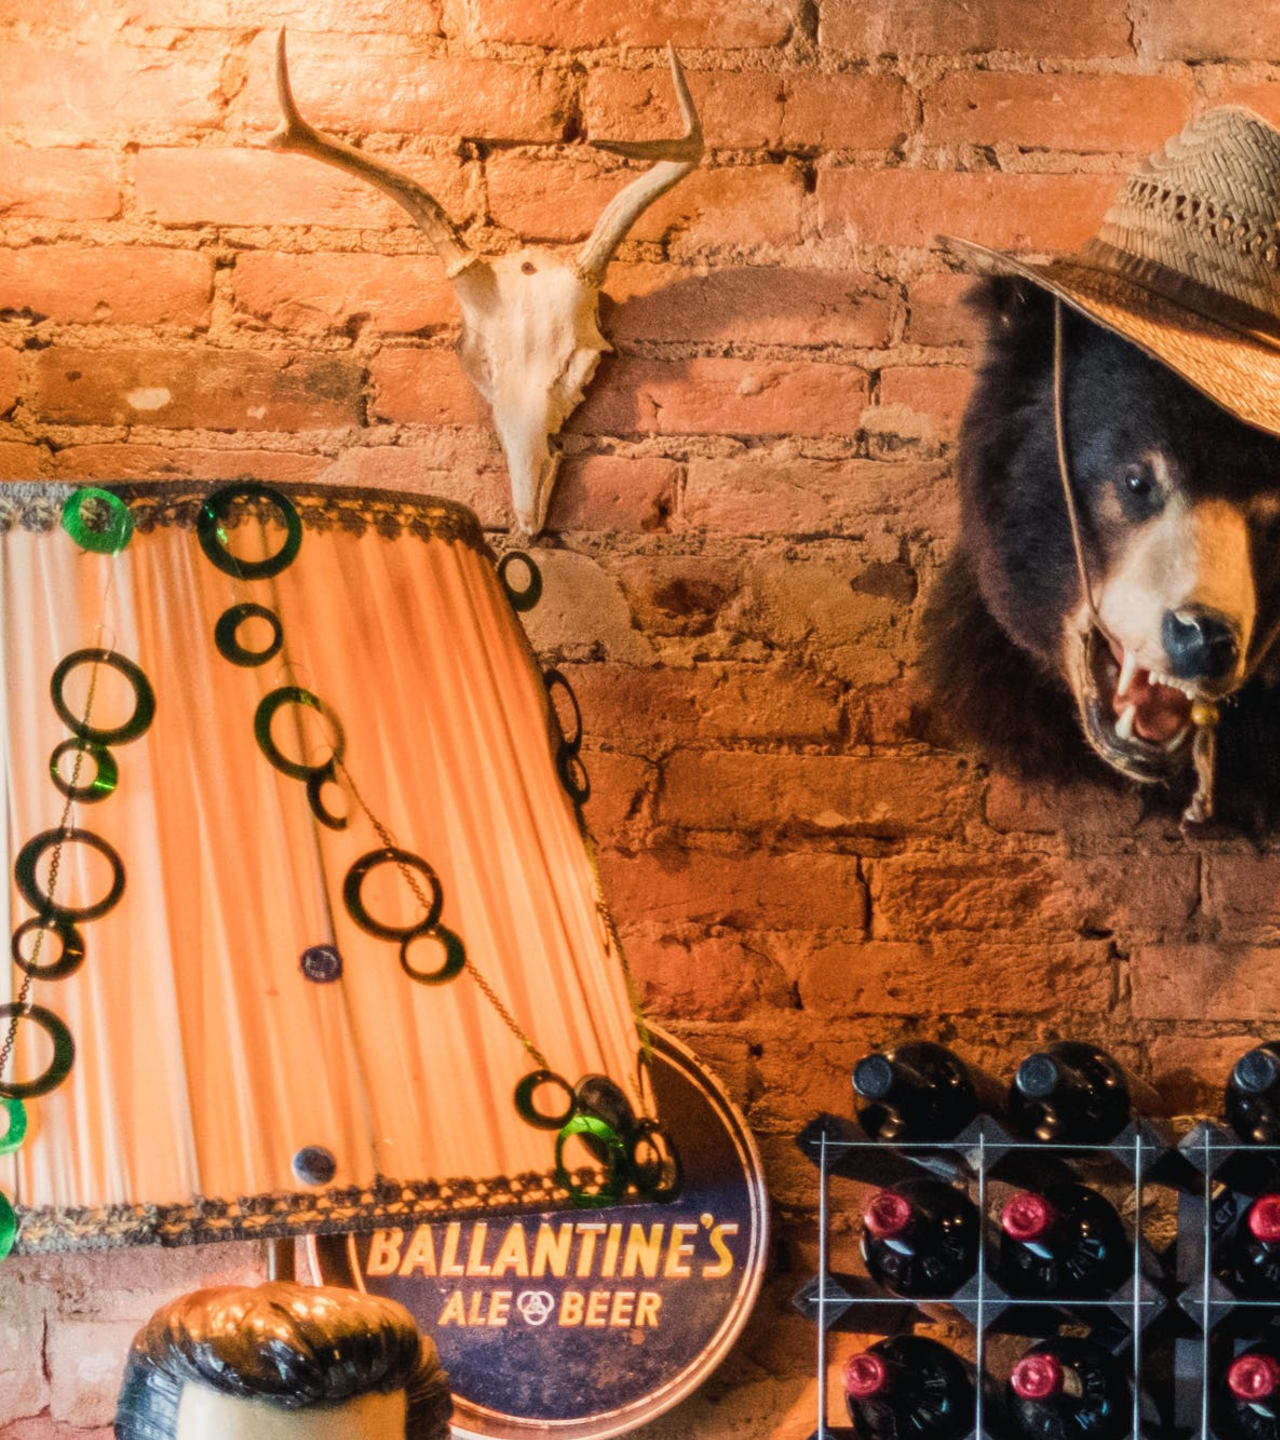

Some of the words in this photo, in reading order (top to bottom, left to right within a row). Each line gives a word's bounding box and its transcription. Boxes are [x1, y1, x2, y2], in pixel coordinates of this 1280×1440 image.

[366, 1213, 740, 1279] BALLANTINE'S
[438, 1290, 514, 1328] ALE
[557, 1290, 663, 1329] BEER
